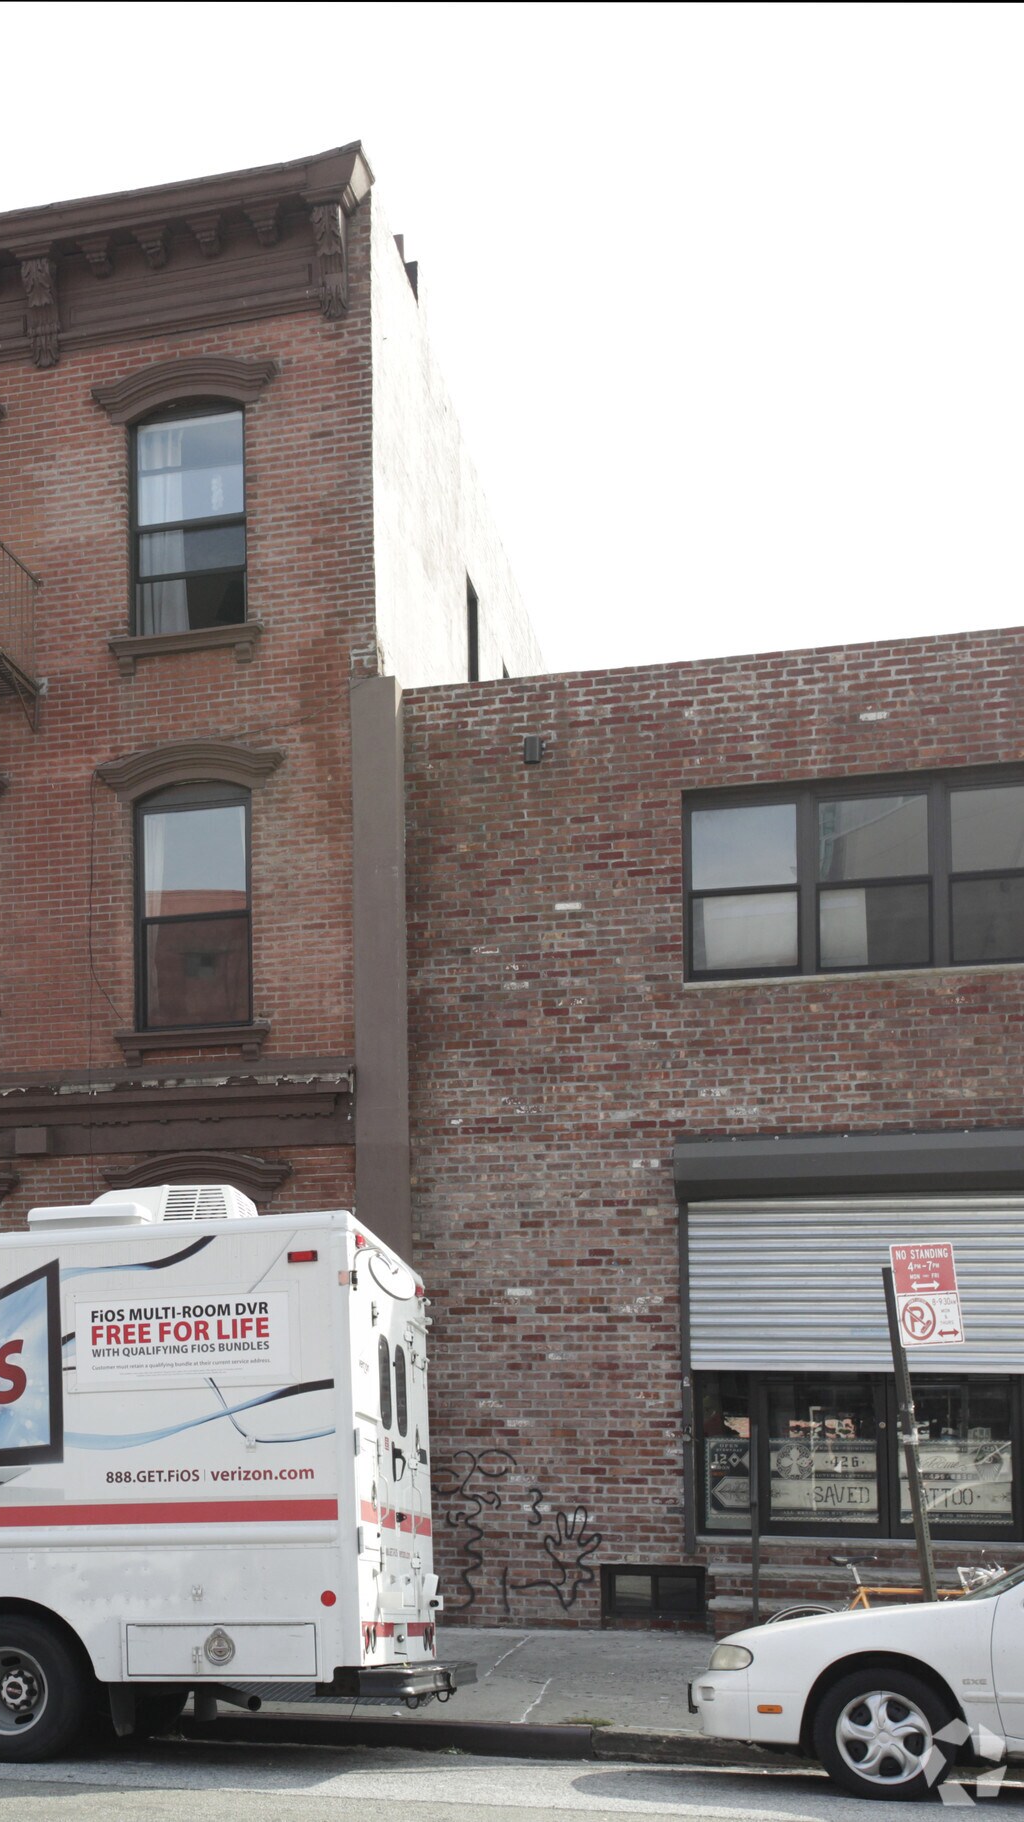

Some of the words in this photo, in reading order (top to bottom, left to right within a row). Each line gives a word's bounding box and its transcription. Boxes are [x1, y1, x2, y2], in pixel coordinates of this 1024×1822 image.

[896, 1250, 907, 1260] NO
[910, 1248, 949, 1260] STANDING
[91, 1308, 125, 1324] FiOS
[129, 1303, 231, 1321] MULTI-ROOM
[235, 1301, 269, 1316] DVR
[91, 1323, 152, 1346] FREE
[158, 1320, 210, 1343] FOR
[216, 1317, 270, 1340] LIFE
[92, 1348, 120, 1358] WITH
[122, 1344, 189, 1358] QUALIFYING
[191, 1343, 216, 1354] FIOS
[218, 1341, 270, 1353] BUNDLES
[149, 1362, 174, 1370] qualifying
[712, 1453, 727, 1465] 12
[106, 1469, 200, 1483] 888.GET.FiOS
[210, 1467, 315, 1481] verizon.com
[814, 1483, 870, 1506] SAVED
